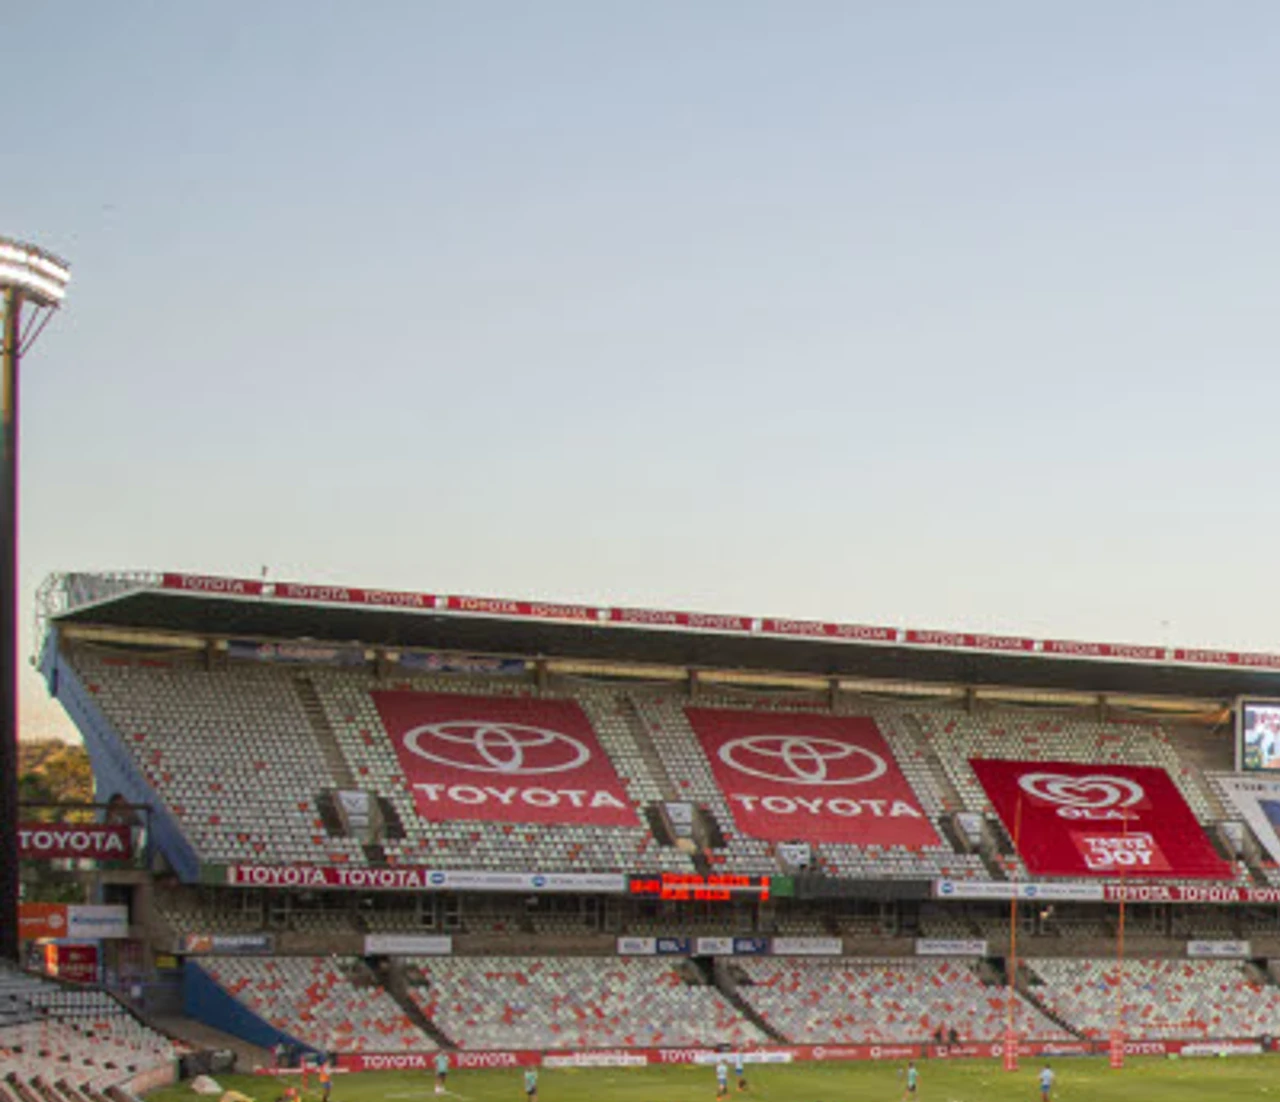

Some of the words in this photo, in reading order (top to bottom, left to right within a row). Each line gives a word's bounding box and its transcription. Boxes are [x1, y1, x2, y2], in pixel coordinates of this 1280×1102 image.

[415, 784, 626, 811] TOYOTA
[733, 796, 922, 818] TOYOTA
[18, 830, 123, 851] TOYOTA
[1090, 847, 1153, 867] JOY
[240, 866, 327, 884] TOYOTA
[336, 869, 420, 887] TOYOTA
[1108, 886, 1169, 900] TOYOTA
[1178, 887, 1239, 901] TOYOTA
[1123, 1043, 1165, 1054] OYOTA
[362, 1055, 426, 1068] TOYOTA
[457, 1053, 517, 1067] TOYOTA
